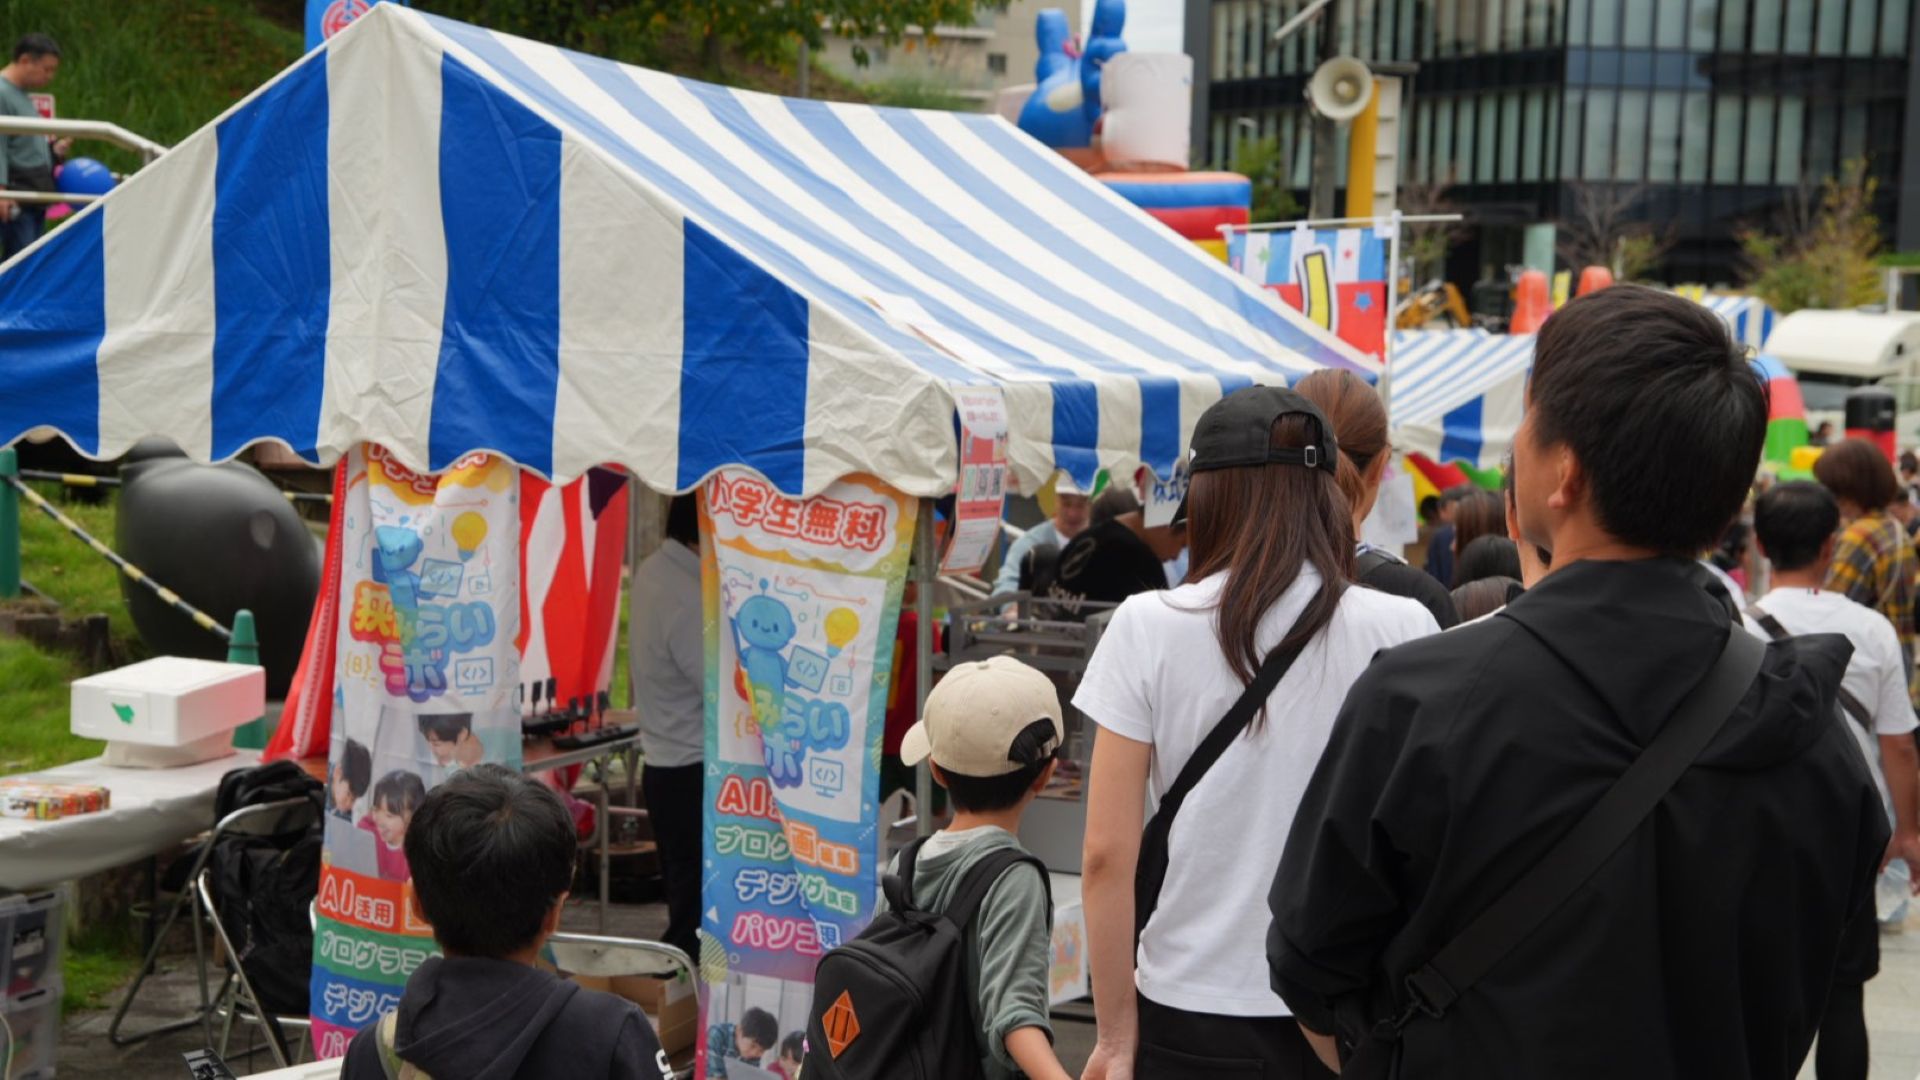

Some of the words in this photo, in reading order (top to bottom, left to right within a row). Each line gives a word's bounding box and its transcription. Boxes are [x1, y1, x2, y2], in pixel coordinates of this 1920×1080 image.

[319, 874, 394, 928] AI活用
[735, 869, 801, 905] デジ
[321, 930, 432, 976] プログラミ
